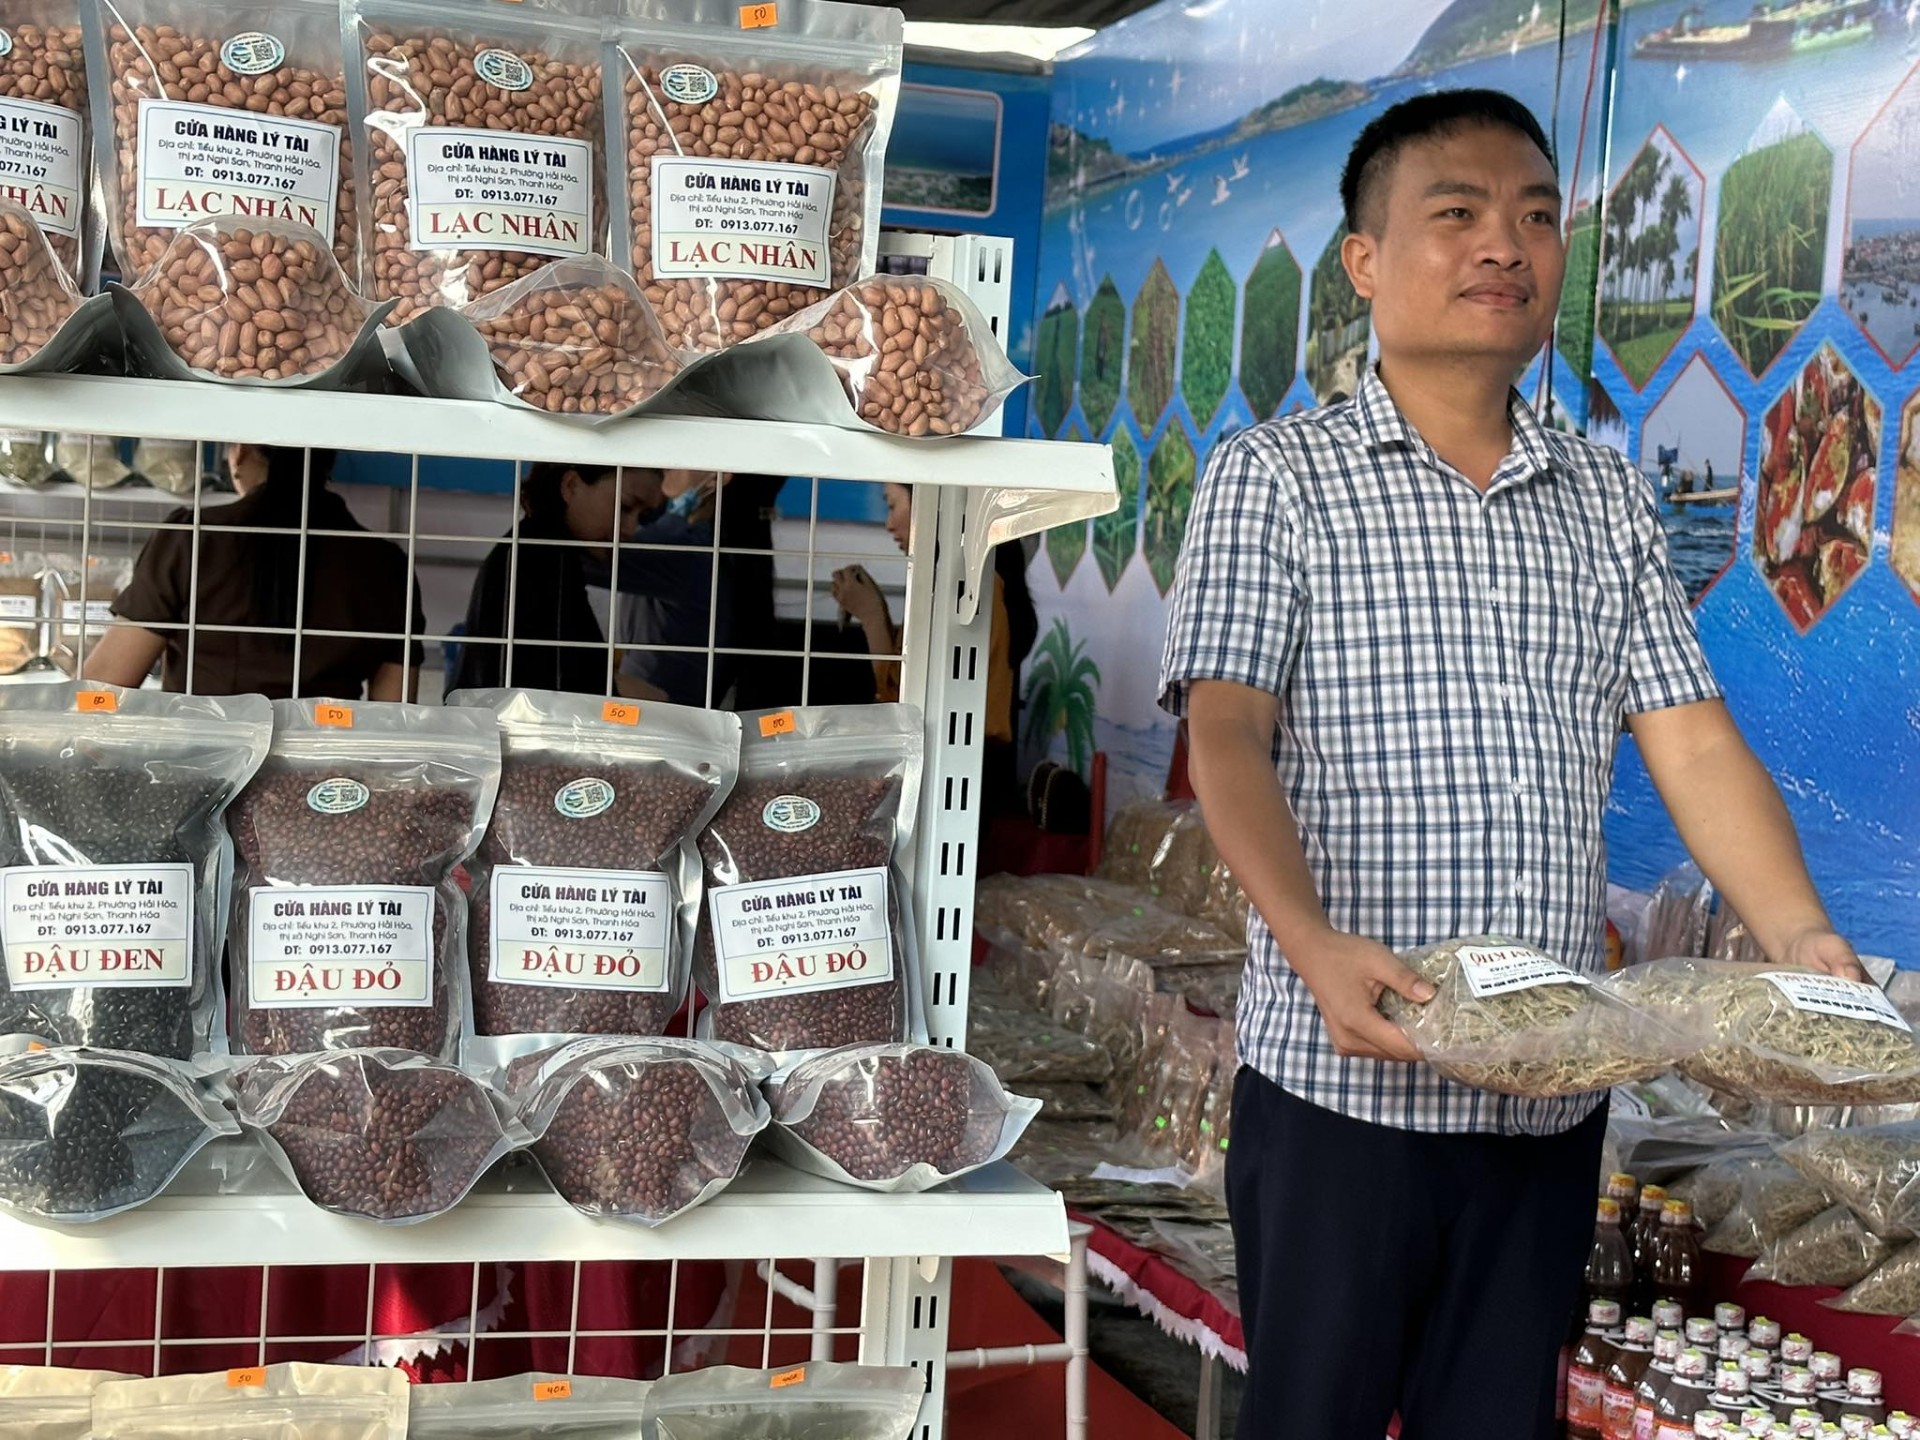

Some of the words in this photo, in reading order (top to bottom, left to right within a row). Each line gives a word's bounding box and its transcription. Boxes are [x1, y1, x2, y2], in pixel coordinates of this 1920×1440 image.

[753, 6, 767, 20] 50
[12, 117, 29, 133] LÝ
[34, 121, 57, 139] TÀI
[175, 119, 208, 138] CỬA
[214, 125, 257, 144] HÀNG
[263, 131, 280, 147] LÝ
[284, 135, 309, 152] TÀI
[442, 142, 474, 159] CỬA
[479, 145, 520, 162] HÀNG
[524, 150, 539, 165] LÝ
[544, 151, 566, 167] TÀI
[0, 162, 47, 177] 077.167
[185, 166, 204, 178] ĐT:
[213, 169, 295, 190] 0913.077.167
[685, 172, 716, 189] CỬA
[721, 175, 761, 192] HÀNG
[767, 179, 782, 194] LÝ
[786, 180, 809, 197] TÀI
[0, 184, 68, 218] HÂN
[157, 188, 222, 217] LẠC
[232, 195, 317, 228] NHÂN
[455, 189, 473, 199] ĐT:
[482, 190, 557, 206] 0913.077.167
[430, 212, 493, 239] LẠC
[501, 212, 578, 243] NHÂN
[695, 219, 712, 228] ĐT:
[721, 220, 798, 234] 0913.077.167
[670, 241, 731, 268] LẠC
[739, 241, 816, 271] NHÂN
[609, 707, 626, 719] 50
[28, 880, 59, 897] CỬA
[65, 880, 109, 895] HÀNG
[115, 879, 131, 895] LÝ
[138, 879, 163, 894] TÀI
[521, 883, 550, 899] CỬA
[556, 885, 596, 901] HÀNG
[602, 888, 618, 902] LÝ
[622, 888, 646, 904] TÀI
[742, 895, 772, 912] CỬA
[777, 891, 816, 908] HÀNG
[820, 887, 835, 901] LÝ
[839, 885, 862, 900] TÀI
[274, 900, 305, 916] CỬA
[310, 900, 351, 915] HÀNG
[357, 900, 374, 915] LÝ
[379, 900, 402, 915] TÀI
[38, 926, 56, 936] ĐT:
[65, 924, 151, 935] 0913.077.167
[531, 927, 548, 937] ĐT:
[555, 928, 633, 942] 0913.077.167
[758, 937, 774, 948] ĐT:
[782, 927, 856, 944] 0913.077.167
[24, 944, 90, 978] ĐẬU
[99, 948, 165, 971] ĐEN
[285, 945, 301, 955] ĐT:
[310, 944, 392, 954] 0913.077.167
[522, 945, 585, 978] ĐẬU
[594, 949, 640, 977] ĐỎ
[752, 953, 817, 985] ĐẬU
[826, 943, 867, 973] ĐỎ
[274, 963, 343, 997] ĐẬU
[353, 961, 401, 991] ĐỎ
